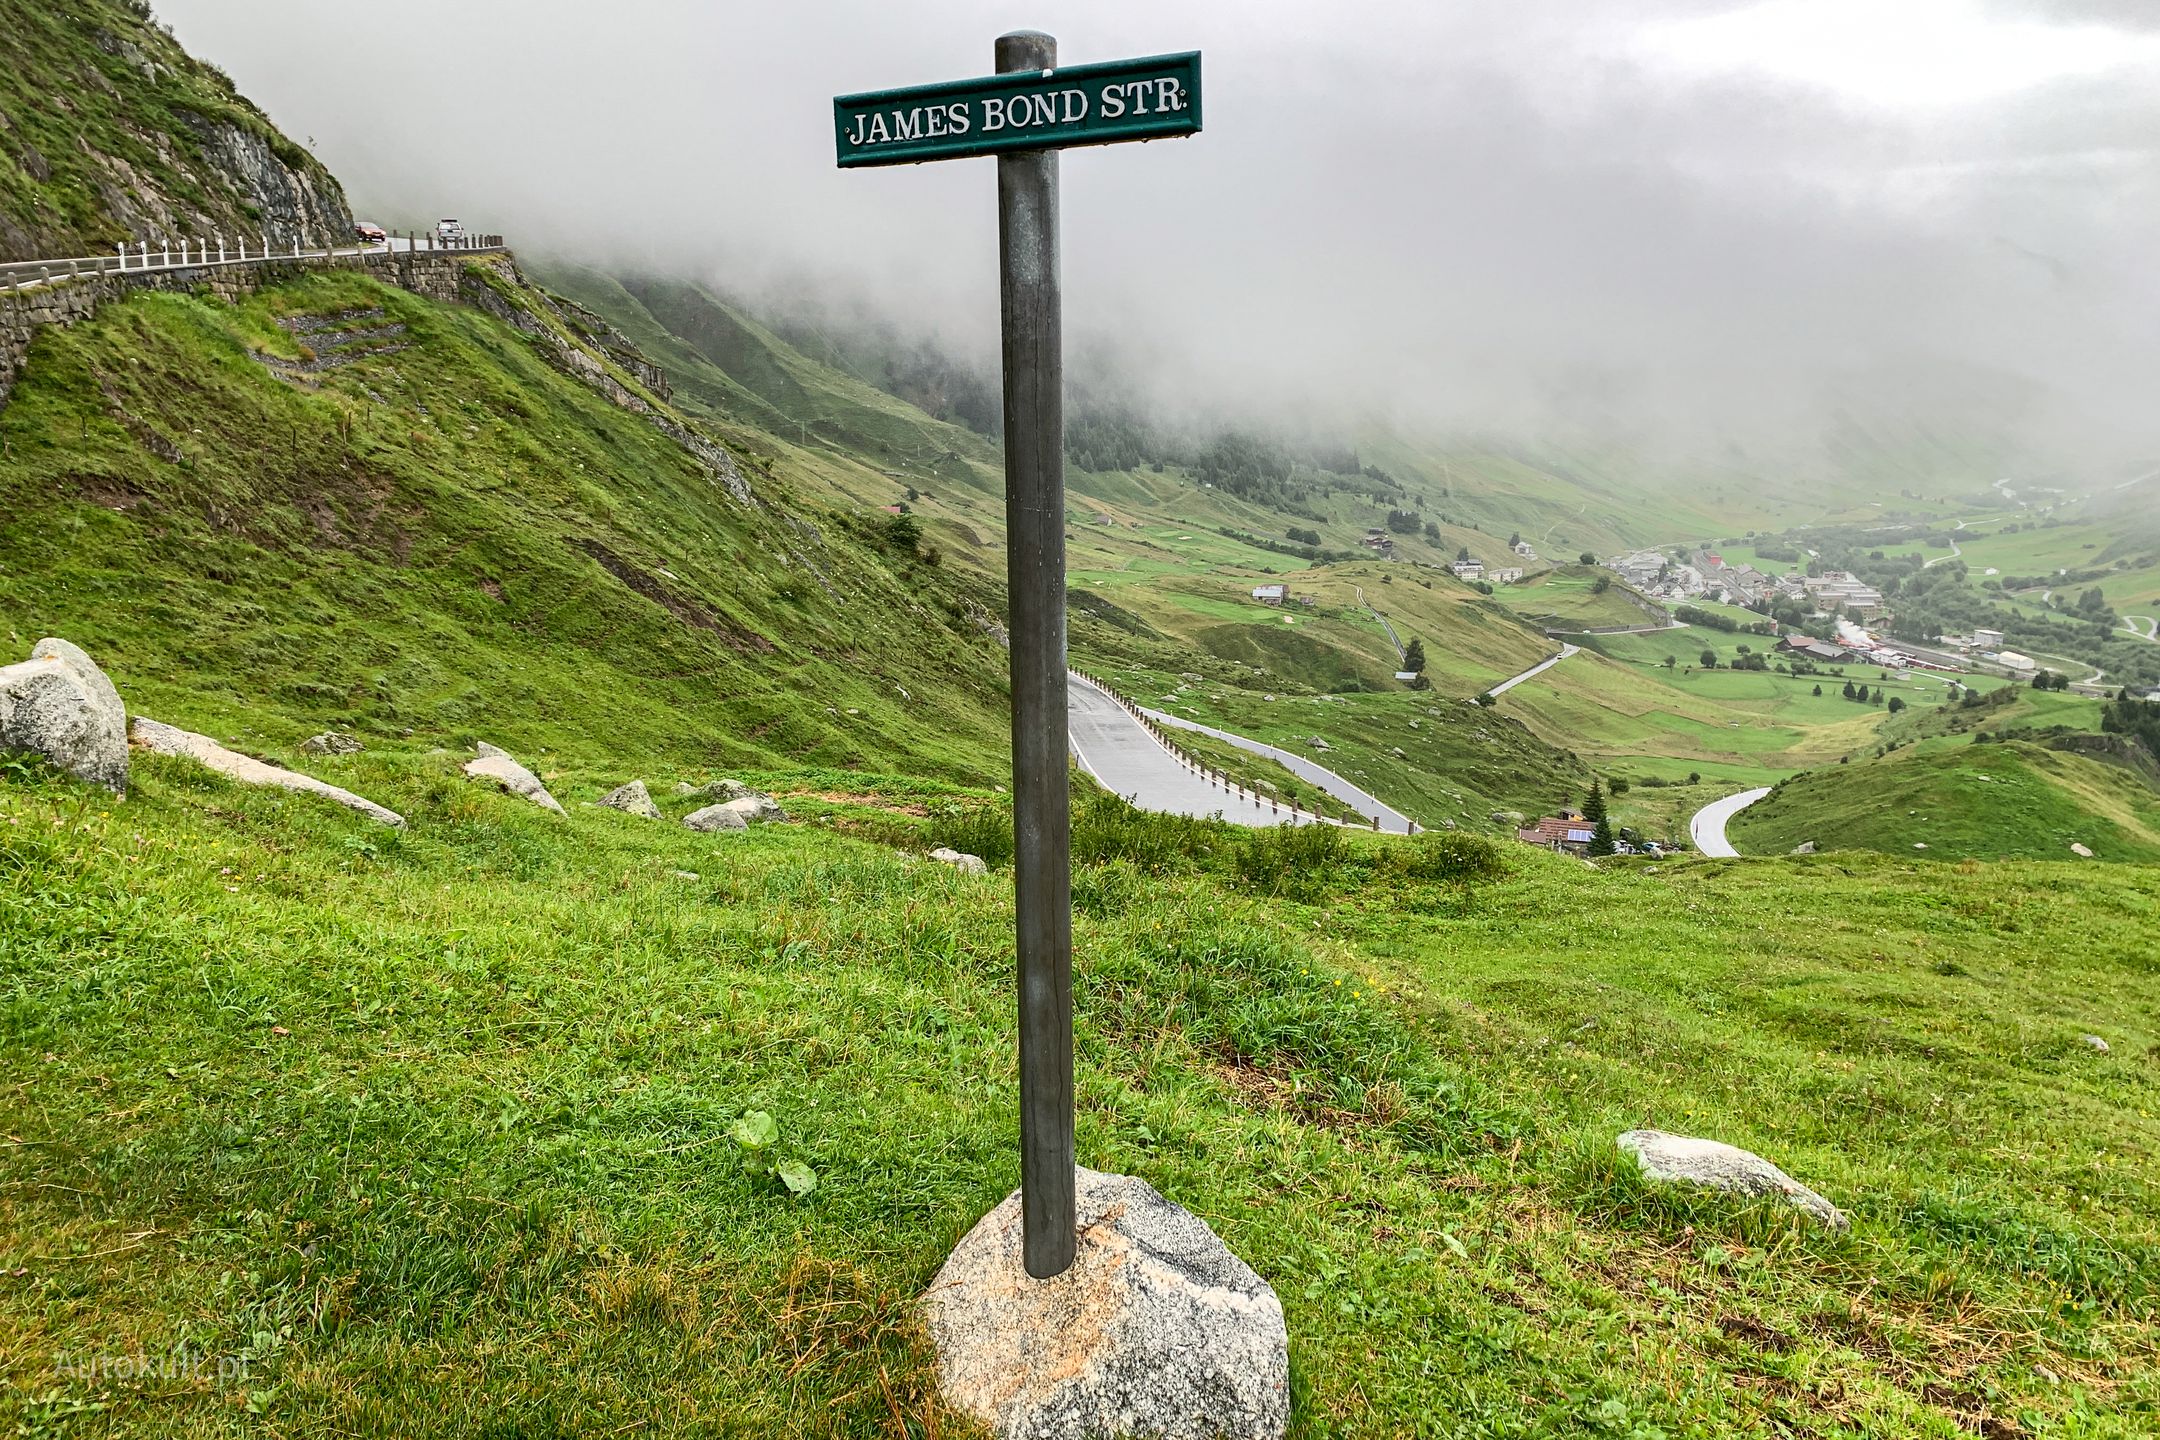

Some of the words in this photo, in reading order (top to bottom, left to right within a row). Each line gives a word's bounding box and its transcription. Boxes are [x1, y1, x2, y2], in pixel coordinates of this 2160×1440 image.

[850, 103, 971, 145] JAMES
[982, 89, 1089, 132] BOND
[1101, 77, 1188, 118] STR.
